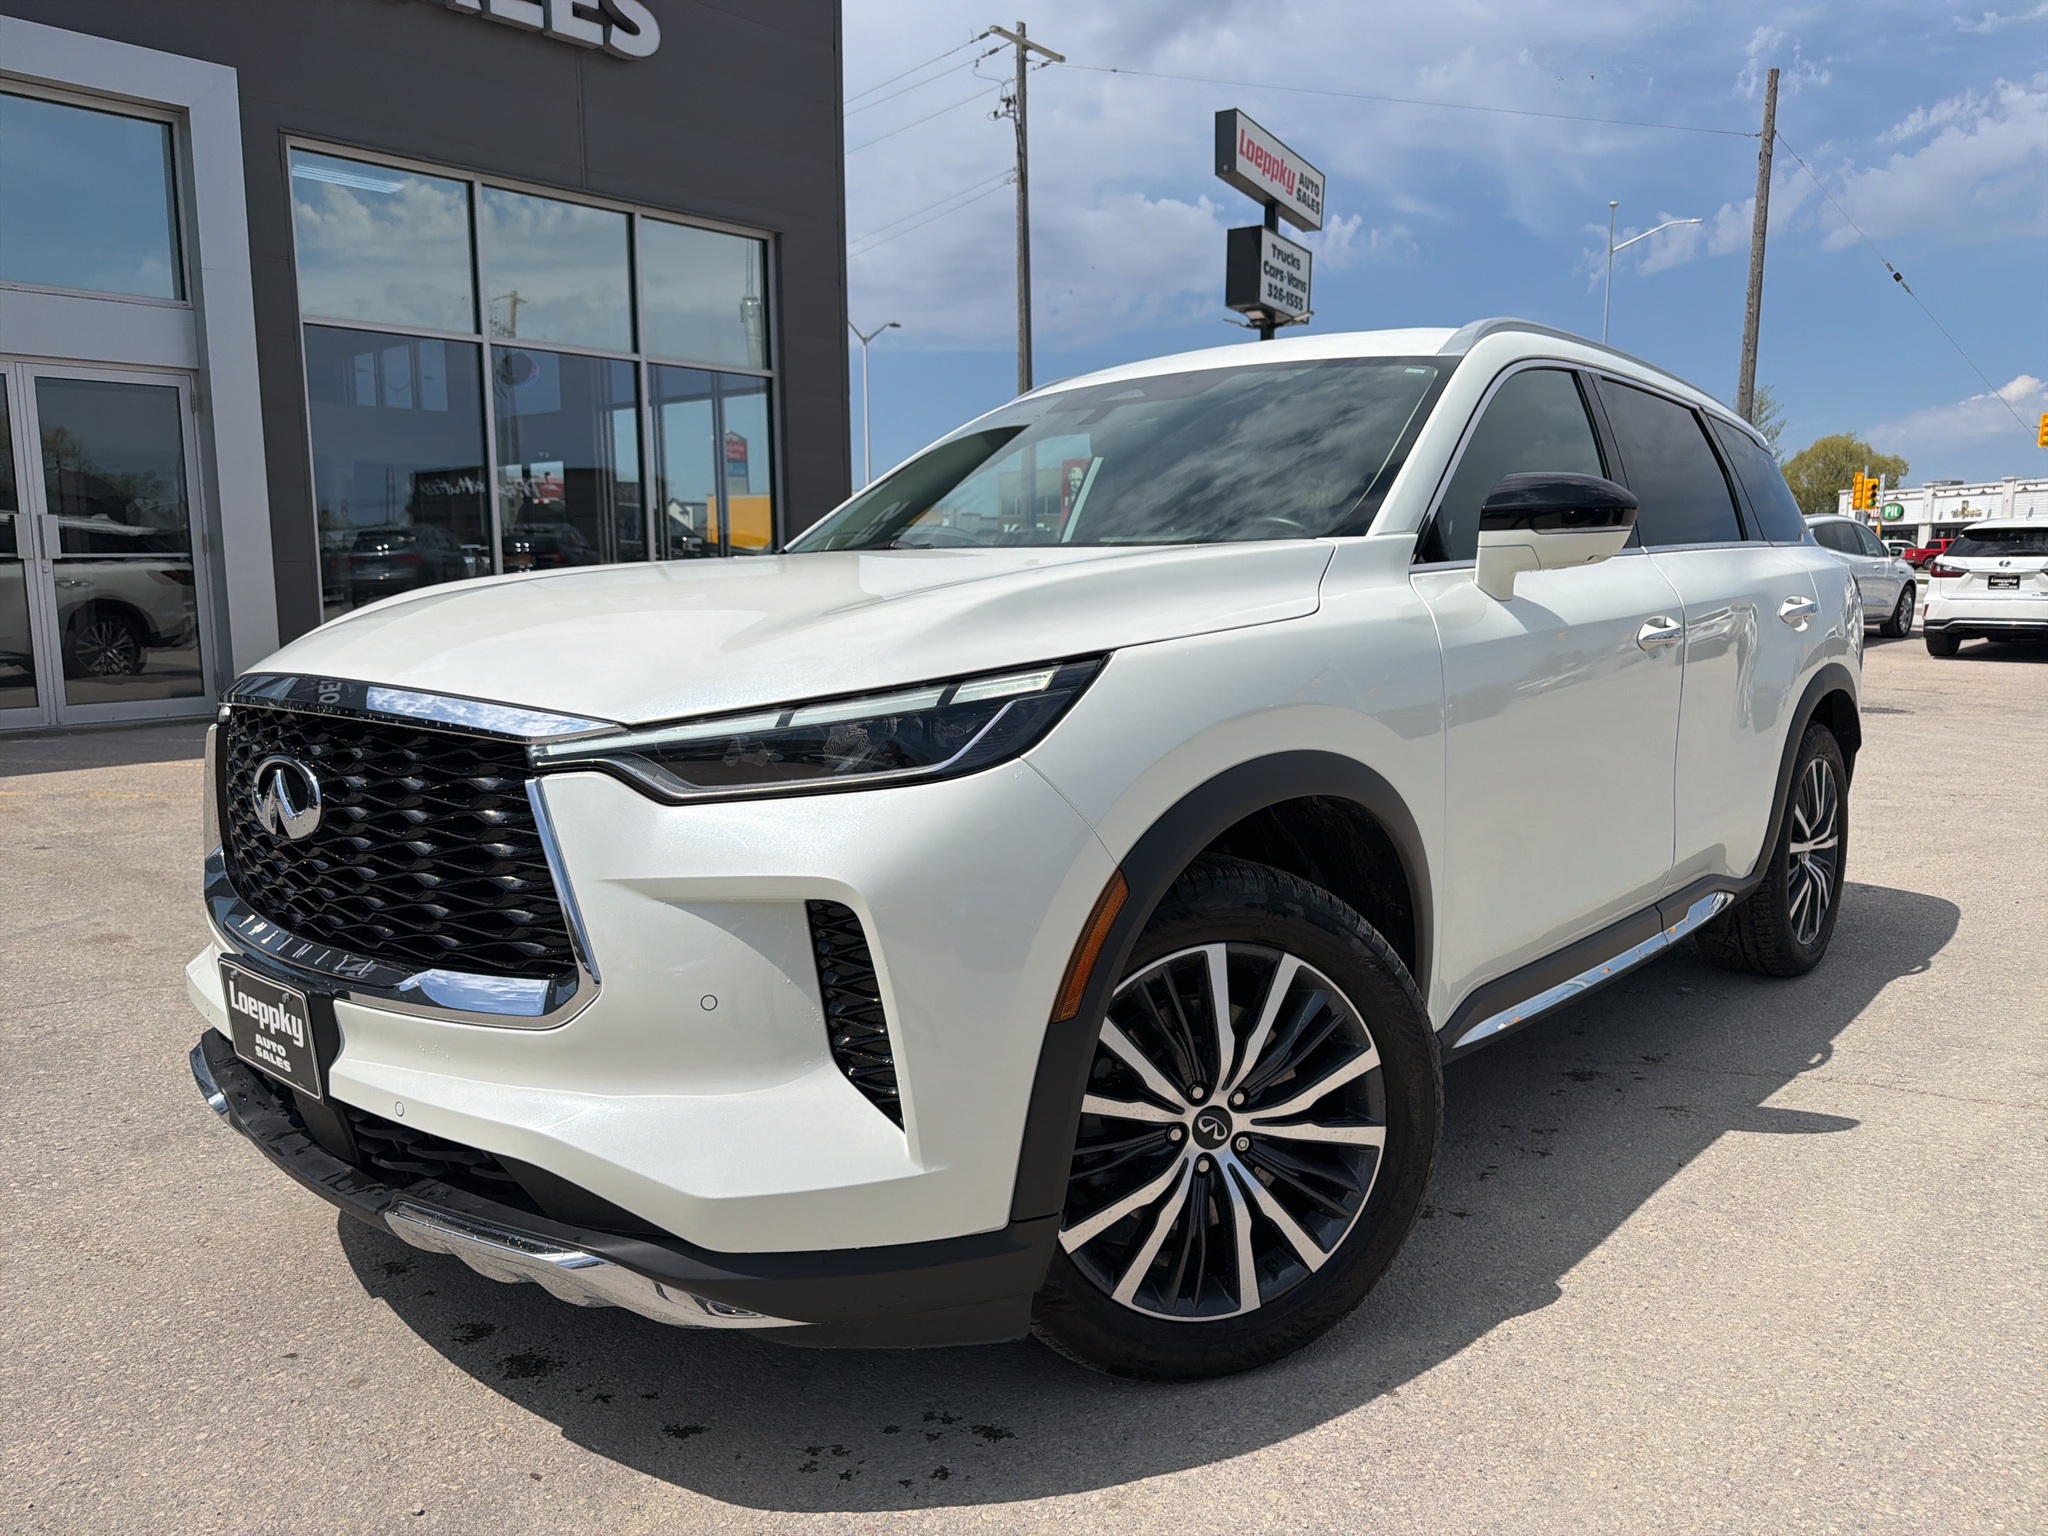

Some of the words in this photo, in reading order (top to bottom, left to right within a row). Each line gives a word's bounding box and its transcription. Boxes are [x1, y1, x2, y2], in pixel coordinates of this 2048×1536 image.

[1239, 127, 1296, 196] Loeppky
[1298, 171, 1320, 198] AUTO
[1296, 187, 1320, 216] SALES
[1271, 242, 1301, 271] Trucks
[1267, 282, 1304, 311] 326-1555
[1884, 505, 1898, 517] Pit
[229, 980, 304, 1048] Loeppky
[255, 1033, 287, 1057] AUTO
[255, 1045, 292, 1073] SALES
